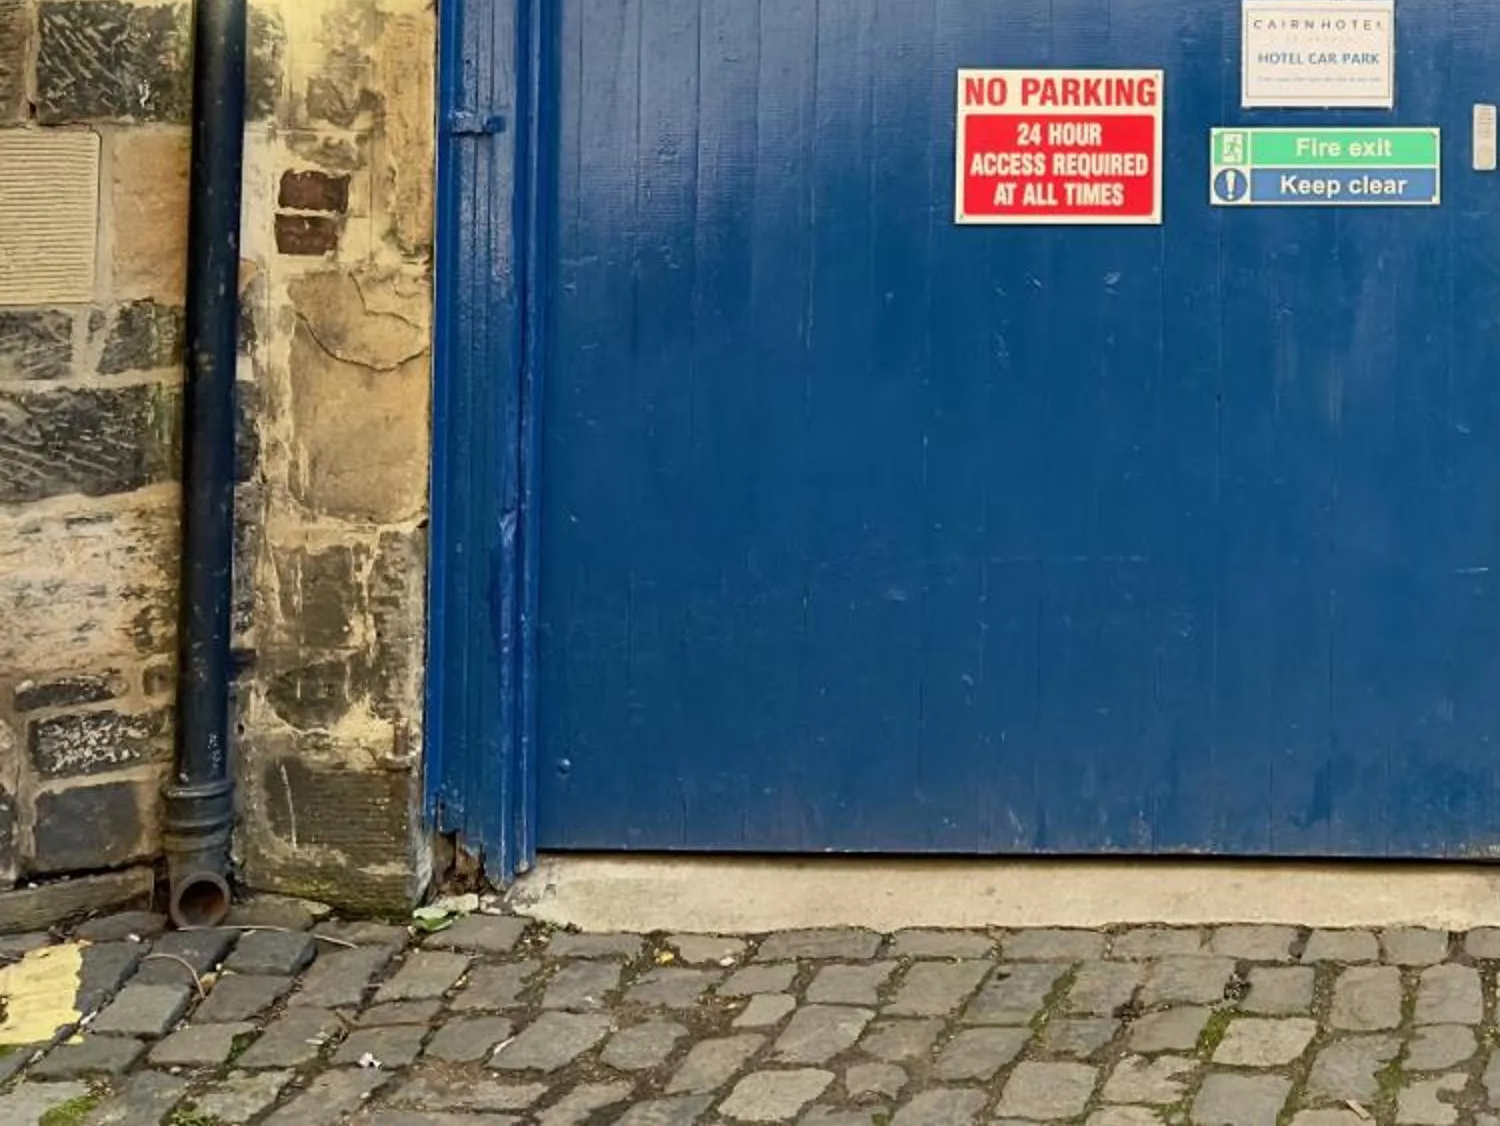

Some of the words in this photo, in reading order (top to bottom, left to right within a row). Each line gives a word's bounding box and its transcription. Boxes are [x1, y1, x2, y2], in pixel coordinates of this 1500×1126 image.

[1257, 52, 1303, 65] HOTEL
[1307, 52, 1338, 65] CAR
[1341, 52, 1380, 65] PARK
[964, 77, 1008, 107] NO
[1021, 77, 1156, 107] PARKING
[1017, 122, 1042, 146] 24
[1048, 122, 1102, 146] HOUR
[1296, 138, 1341, 157] Fire
[1349, 138, 1392, 157] exit
[970, 152, 1046, 176] ACCESS
[1053, 153, 1149, 178] REQUIRED
[993, 182, 1017, 206] AT
[1022, 182, 1058, 206] ALL
[1064, 182, 1124, 206] TIMES
[1280, 175, 1341, 198] Keep
[1348, 175, 1408, 195] clear
